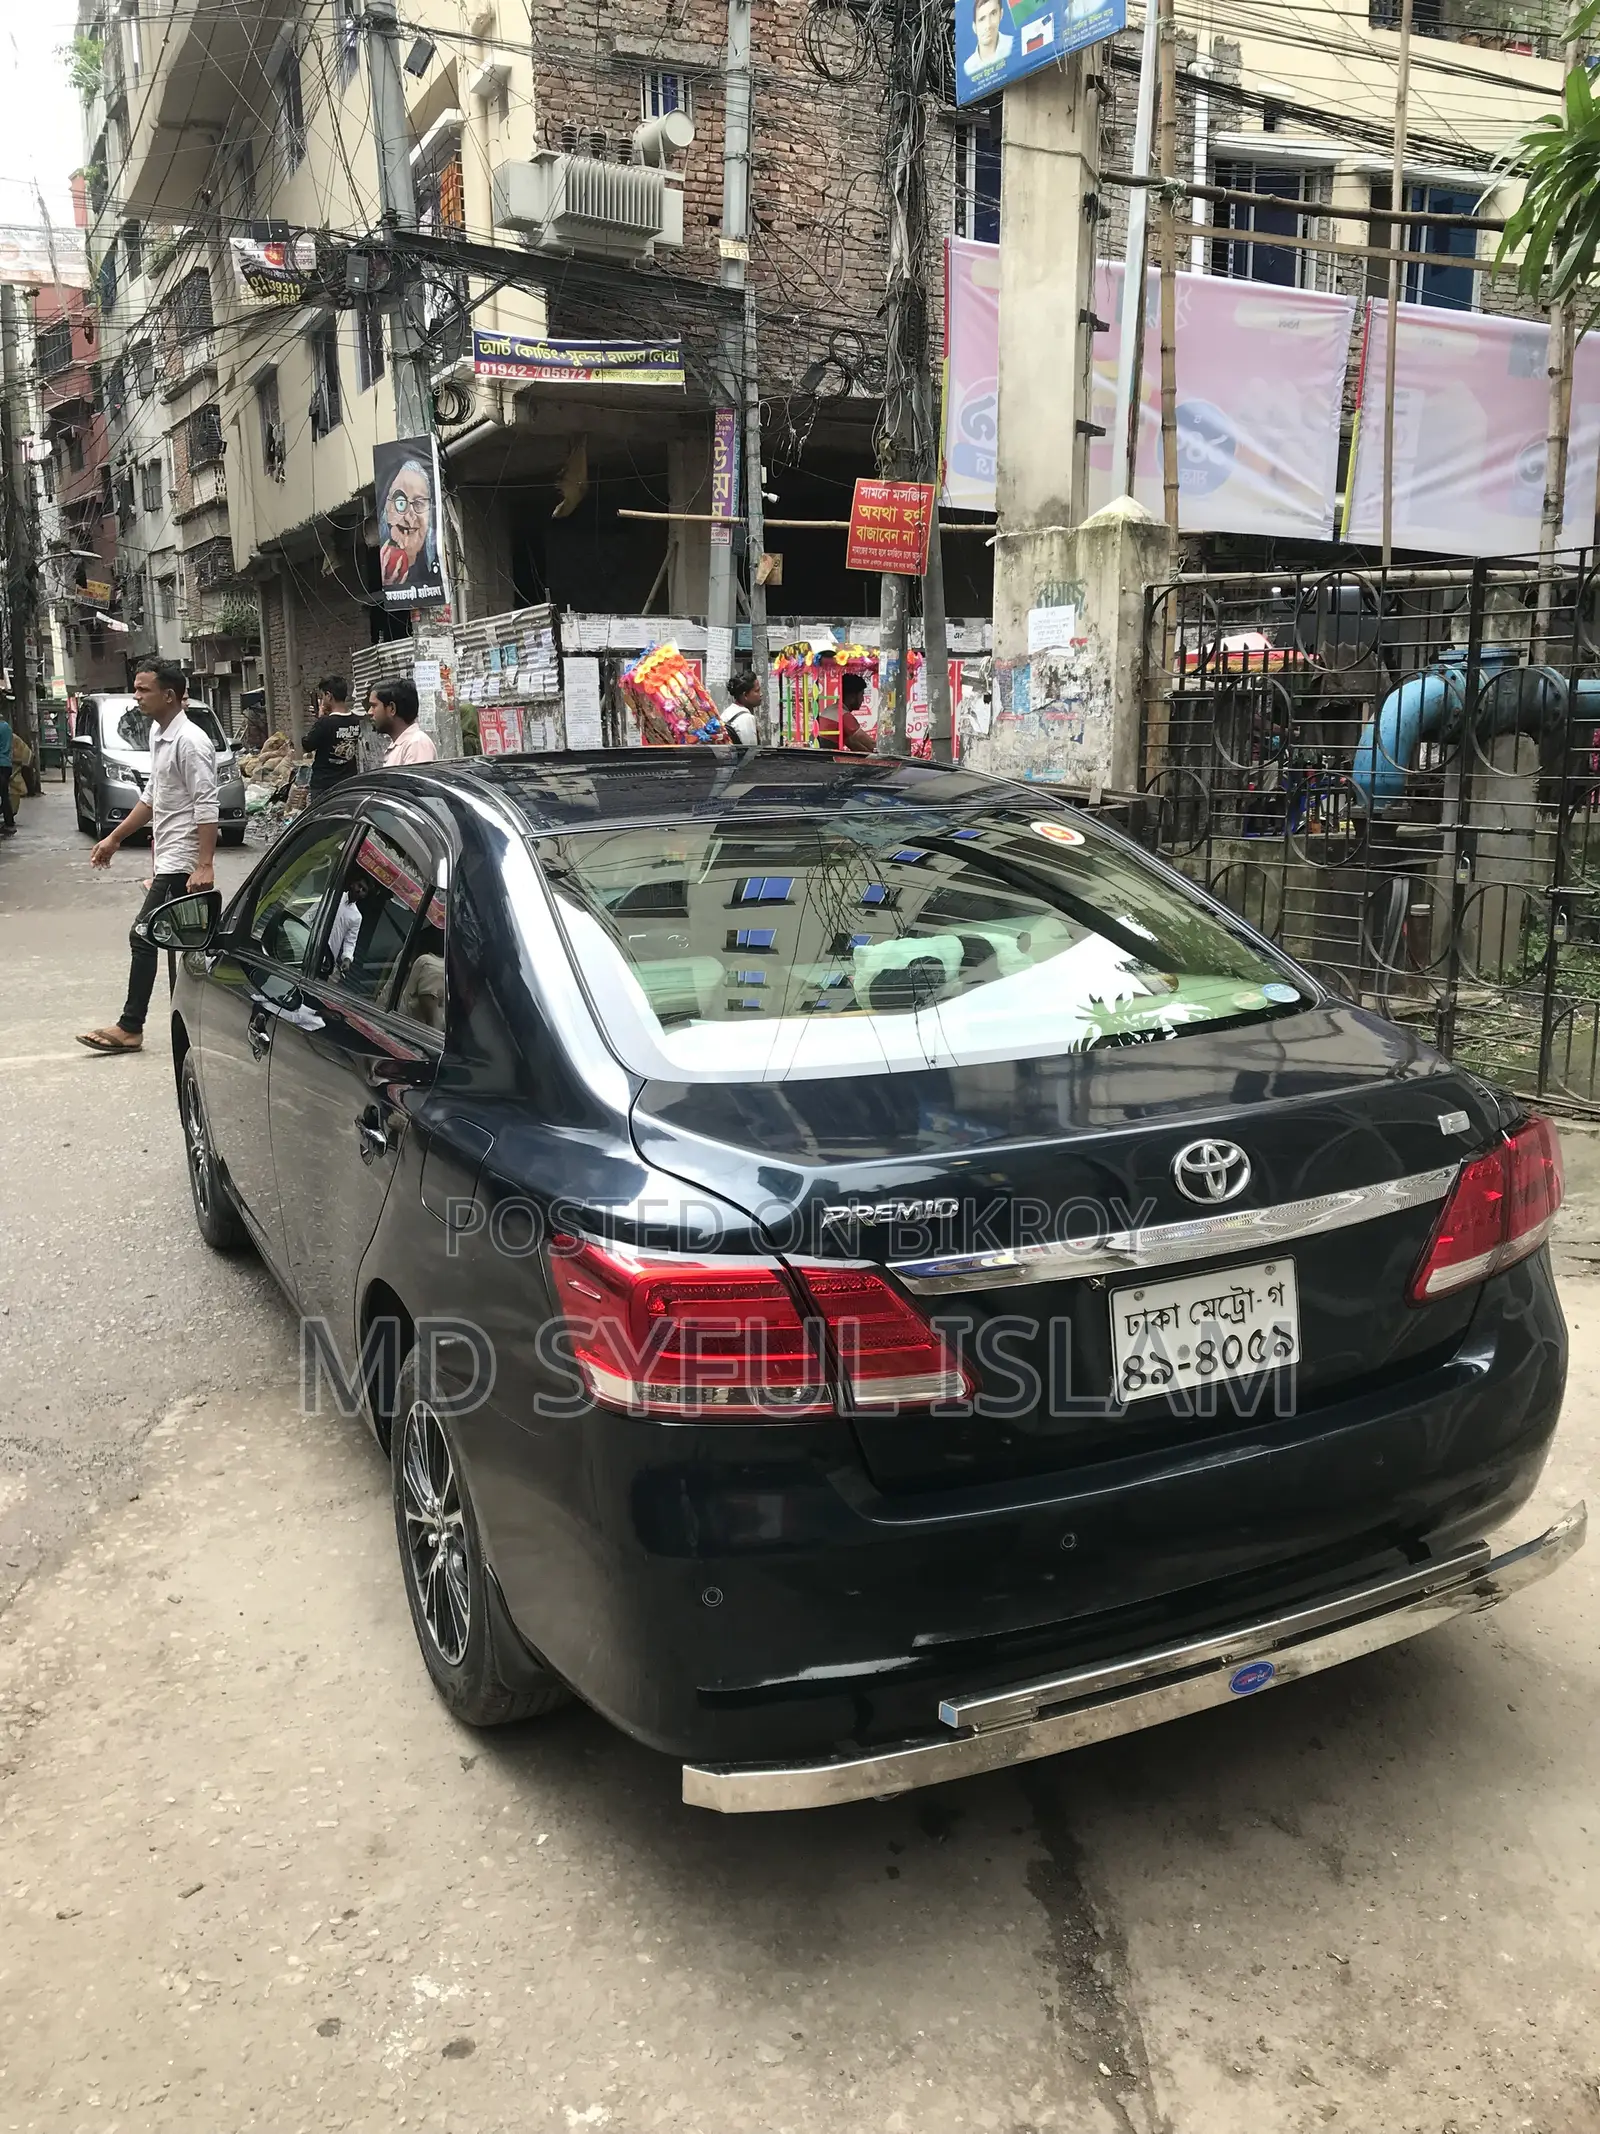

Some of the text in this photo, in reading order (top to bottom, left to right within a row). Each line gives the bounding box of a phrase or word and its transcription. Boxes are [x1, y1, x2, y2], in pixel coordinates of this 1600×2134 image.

[480, 363, 587, 380] 01942-705972
[860, 486, 929, 504] সামনে মসজিদ
[858, 504, 898, 523] অযথা
[856, 524, 900, 544] বাজাবেন
[417, 584, 442, 599] হাসিনা
[821, 1198, 960, 1228] PREMIO
[1124, 1303, 1181, 1337] ঢাকা
[1122, 1325, 1295, 1392] ৪৯-৪০৫৯
